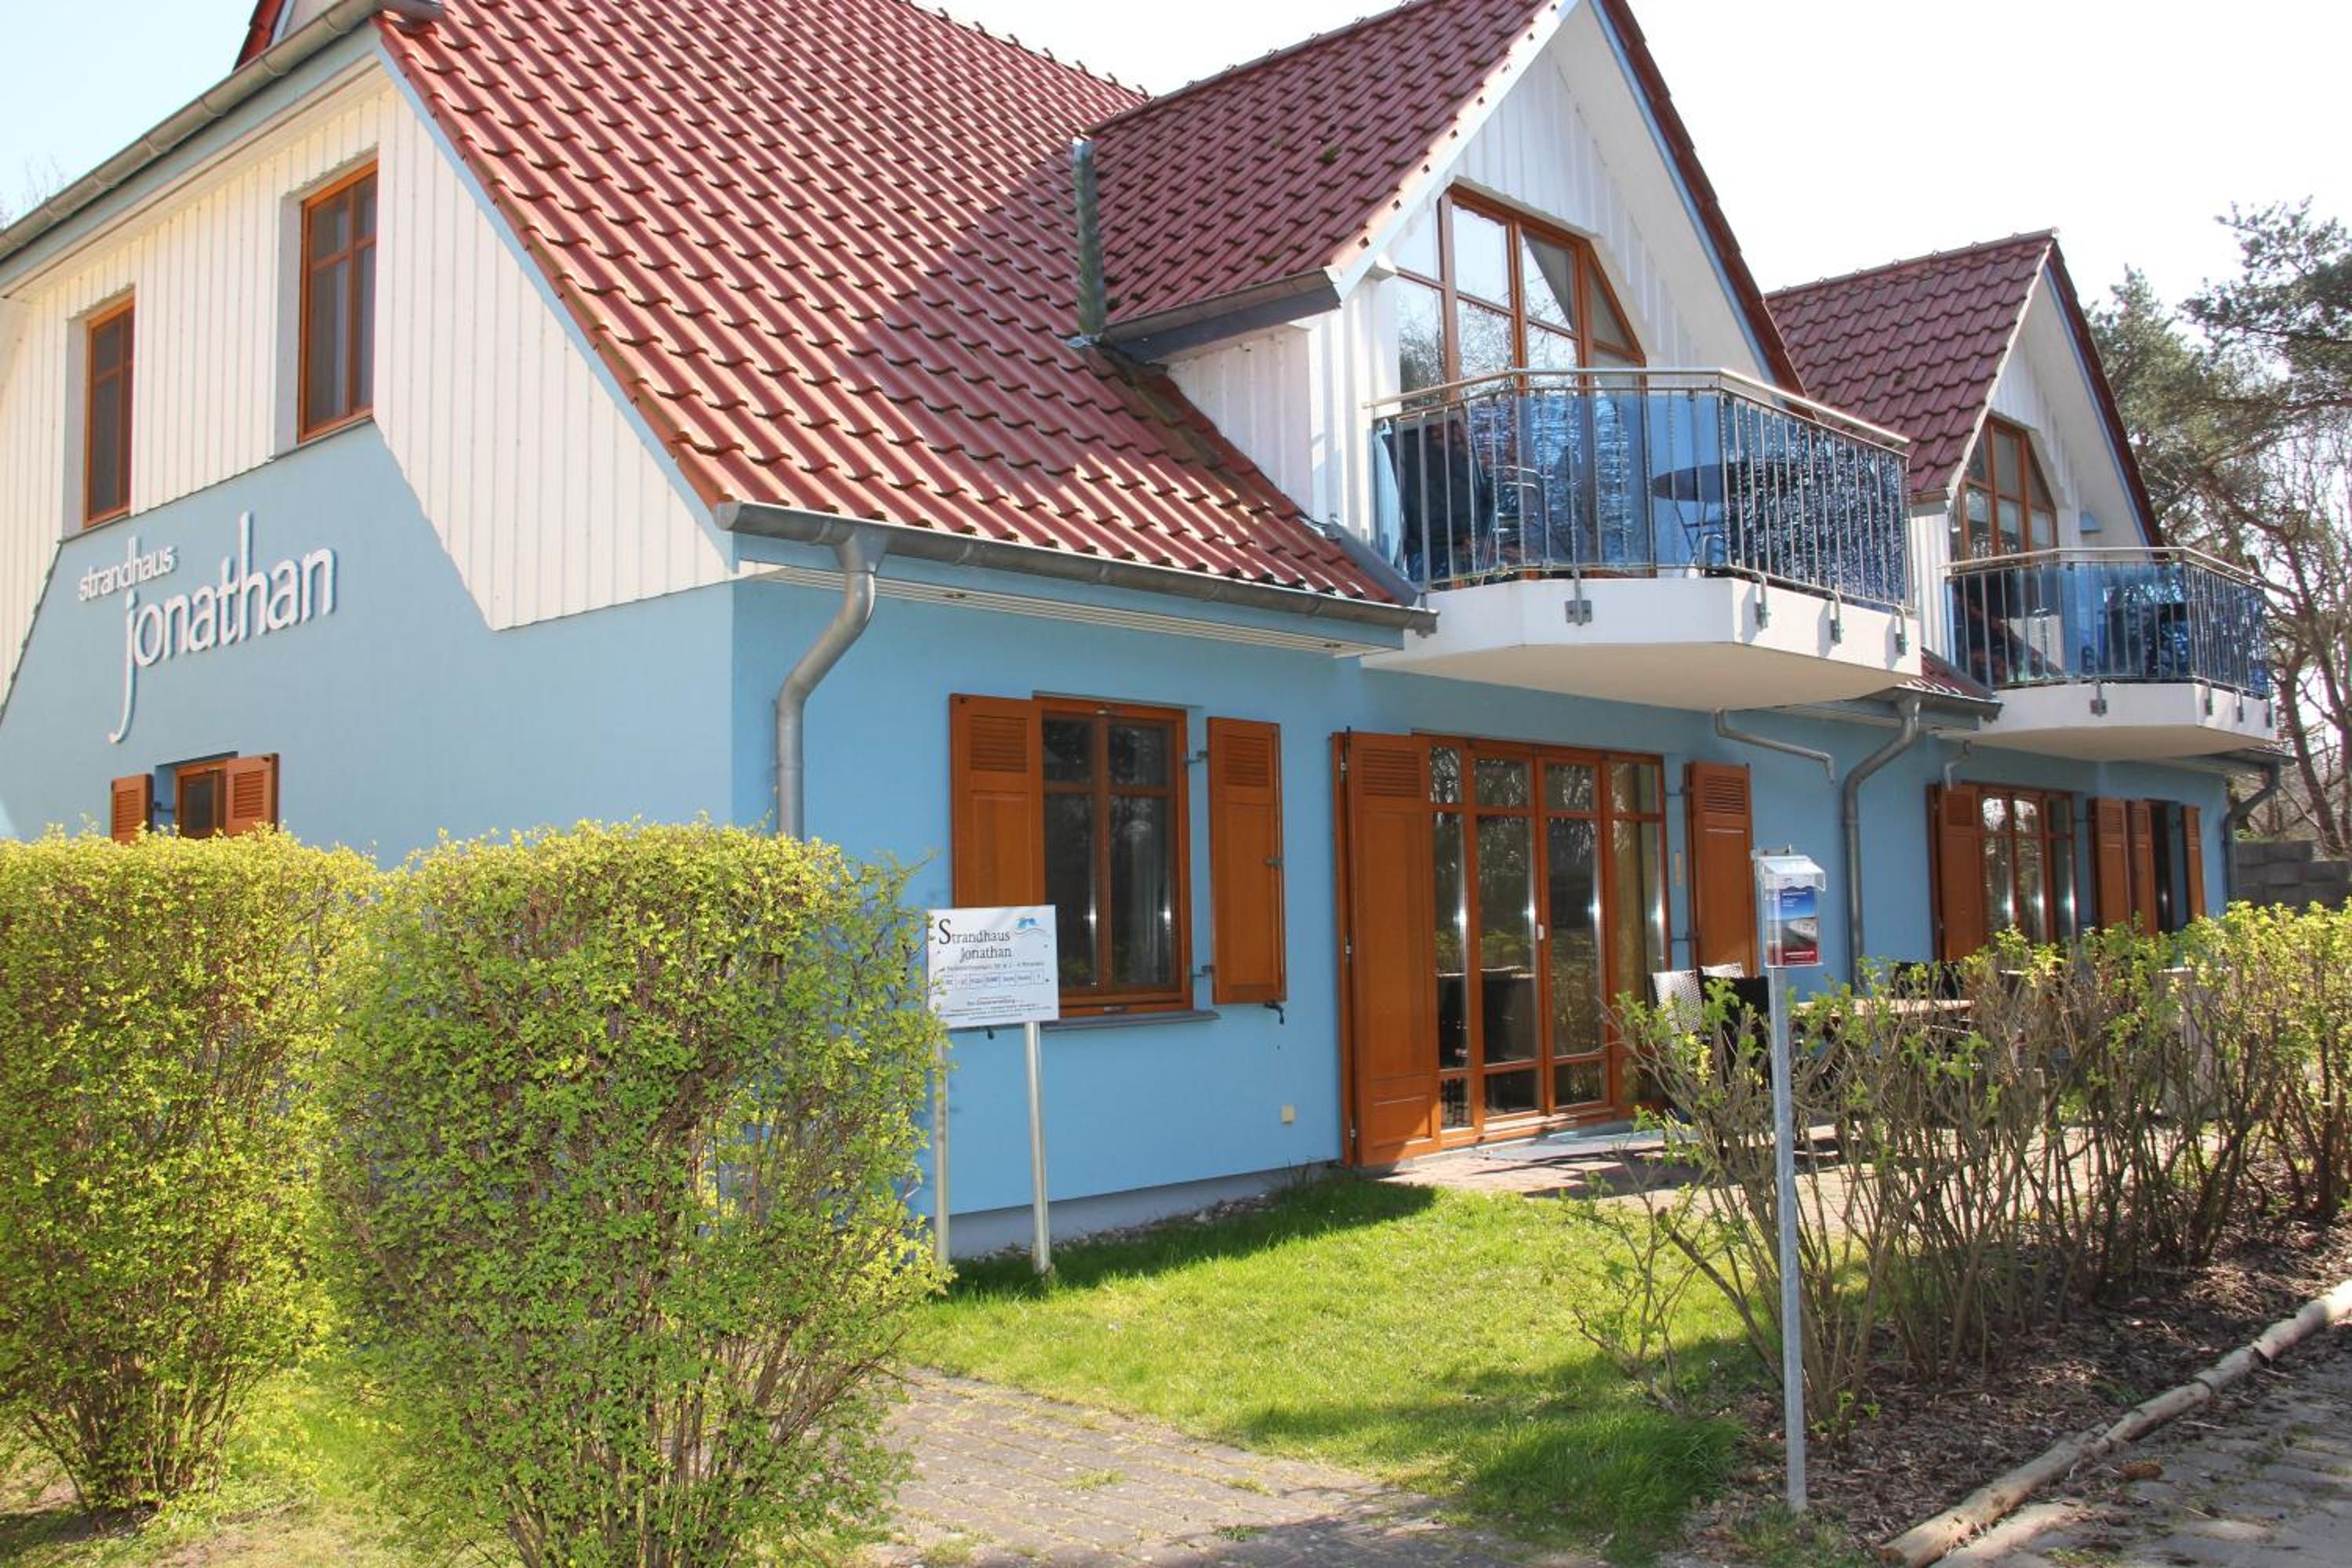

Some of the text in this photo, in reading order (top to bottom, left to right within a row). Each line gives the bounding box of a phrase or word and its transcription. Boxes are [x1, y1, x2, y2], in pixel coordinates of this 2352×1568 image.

[78, 538, 176, 601] strandhaus
[108, 510, 336, 743] jonathan
[938, 918, 1011, 944] Strandhaus
